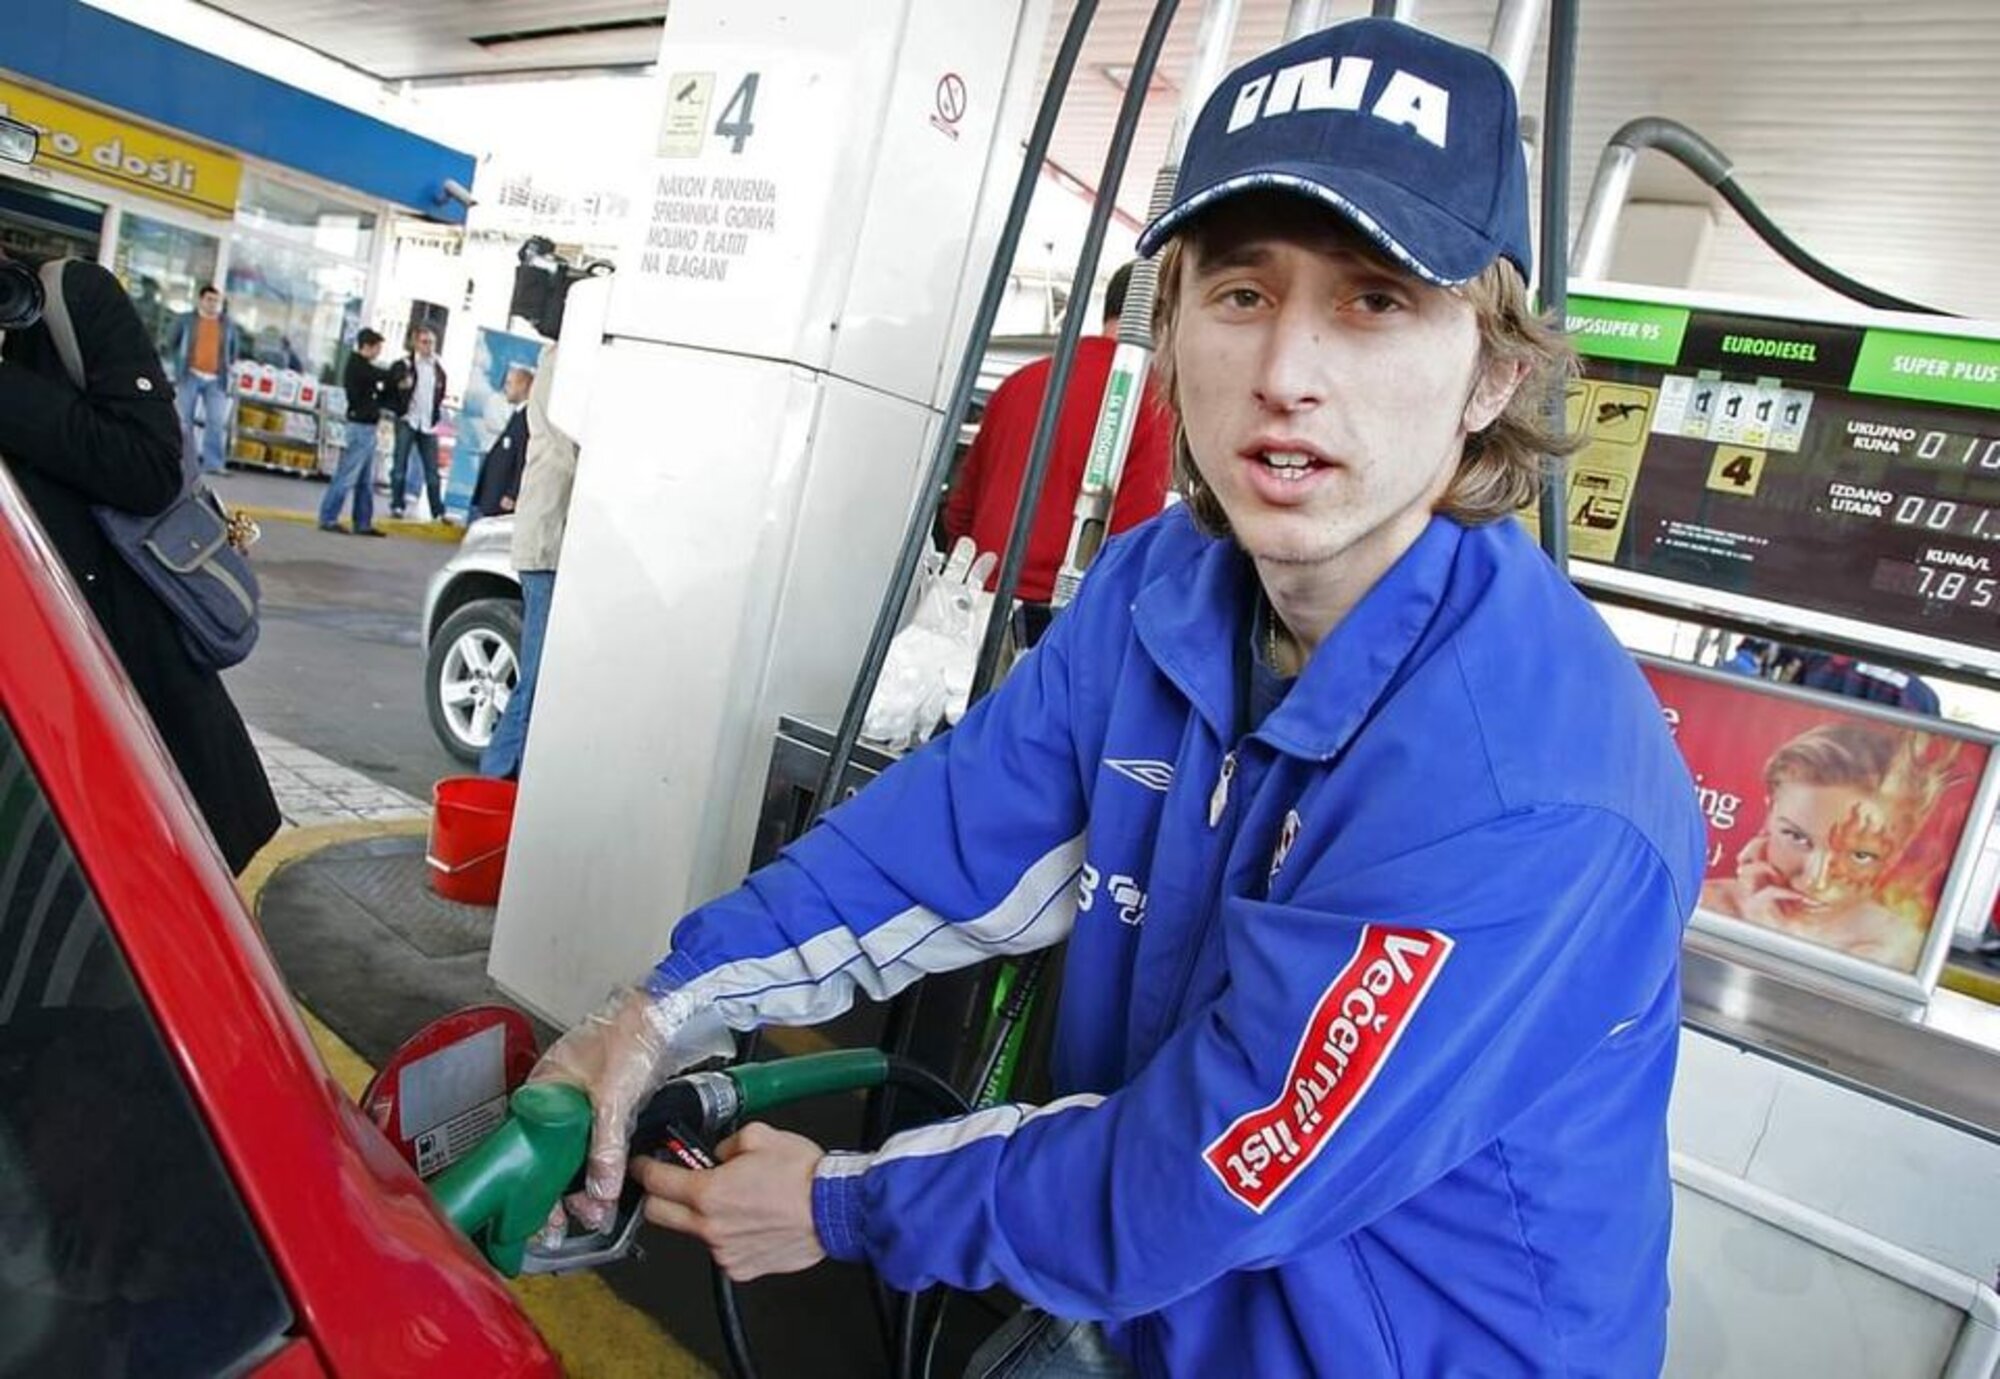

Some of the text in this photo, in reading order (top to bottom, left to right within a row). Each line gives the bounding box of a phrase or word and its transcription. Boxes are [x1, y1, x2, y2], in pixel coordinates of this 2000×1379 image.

[714, 72, 760, 154] 4
[657, 175, 776, 202] NAKON PUNJENJA
[724, 205, 775, 230] GORIVA
[646, 225, 748, 255] MOLIMO PLATITI
[640, 252, 729, 281] NA BLAGAJNI
[1565, 316, 1660, 340] UROSUPER 95
[1722, 335, 1817, 362] EURODIESEL
[1892, 355, 1999, 382] SUPER PLUS
[1847, 421, 1917, 441] UKUPNO
[1853, 437, 1900, 455] KUNA
[1721, 455, 1753, 486] 4
[1829, 483, 1893, 504] IZDANO
[1831, 498, 1882, 517] LITARA
[1896, 496, 2000, 540] 001.
[1226, 935, 1431, 1190] Večernji list
